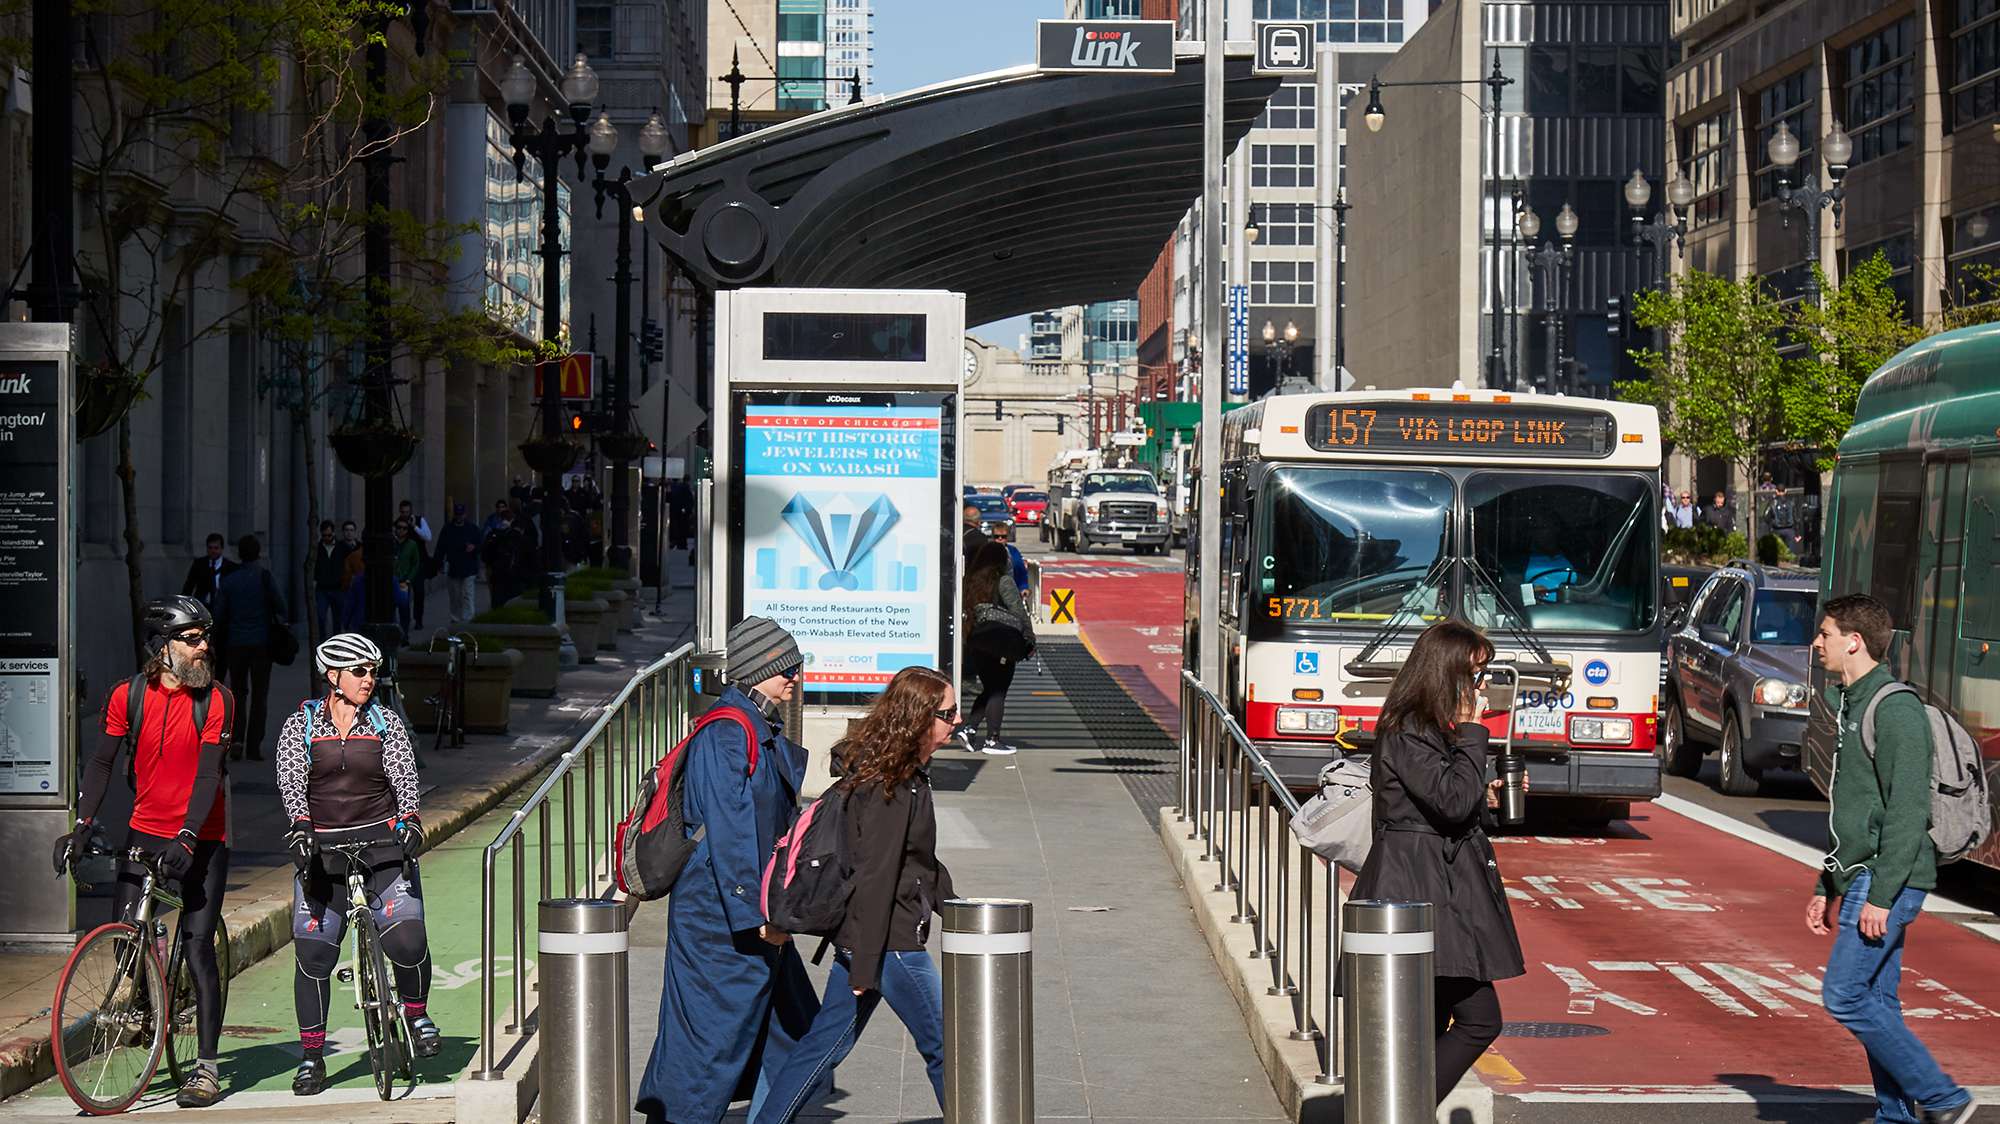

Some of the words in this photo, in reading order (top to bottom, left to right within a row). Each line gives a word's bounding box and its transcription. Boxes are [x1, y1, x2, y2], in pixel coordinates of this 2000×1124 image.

[0, 373, 31, 394] ink
[1328, 409, 1377, 445] 157
[1400, 417, 1439, 441] VIA
[1448, 418, 1504, 442] LOOP
[1513, 420, 1566, 444] LINK
[762, 430, 817, 443] VISIT
[823, 431, 922, 445] HISTORIC
[762, 446, 868, 459] JEWELERS
[874, 447, 921, 460] ROW
[782, 462, 811, 473] ON
[819, 463, 901, 475] WABASH
[1263, 555, 1275, 570] C
[780, 604, 809, 612] Stores
[830, 605, 883, 613] Restaurants
[885, 605, 910, 614] Open
[1269, 597, 1322, 619] 5771
[799, 616, 856, 625] Construction
[858, 617, 868, 625] of
[871, 617, 885, 625] the
[888, 618, 909, 626] New
[792, 629, 844, 637] ton-Wabash
[847, 629, 886, 638] Elevated
[888, 630, 920, 638] Station
[9, 661, 49, 670] services
[848, 655, 873, 663] CDOT
[852, 674, 888, 682] EMANU
[1587, 667, 1607, 678] cta
[1521, 690, 1575, 709] 1960
